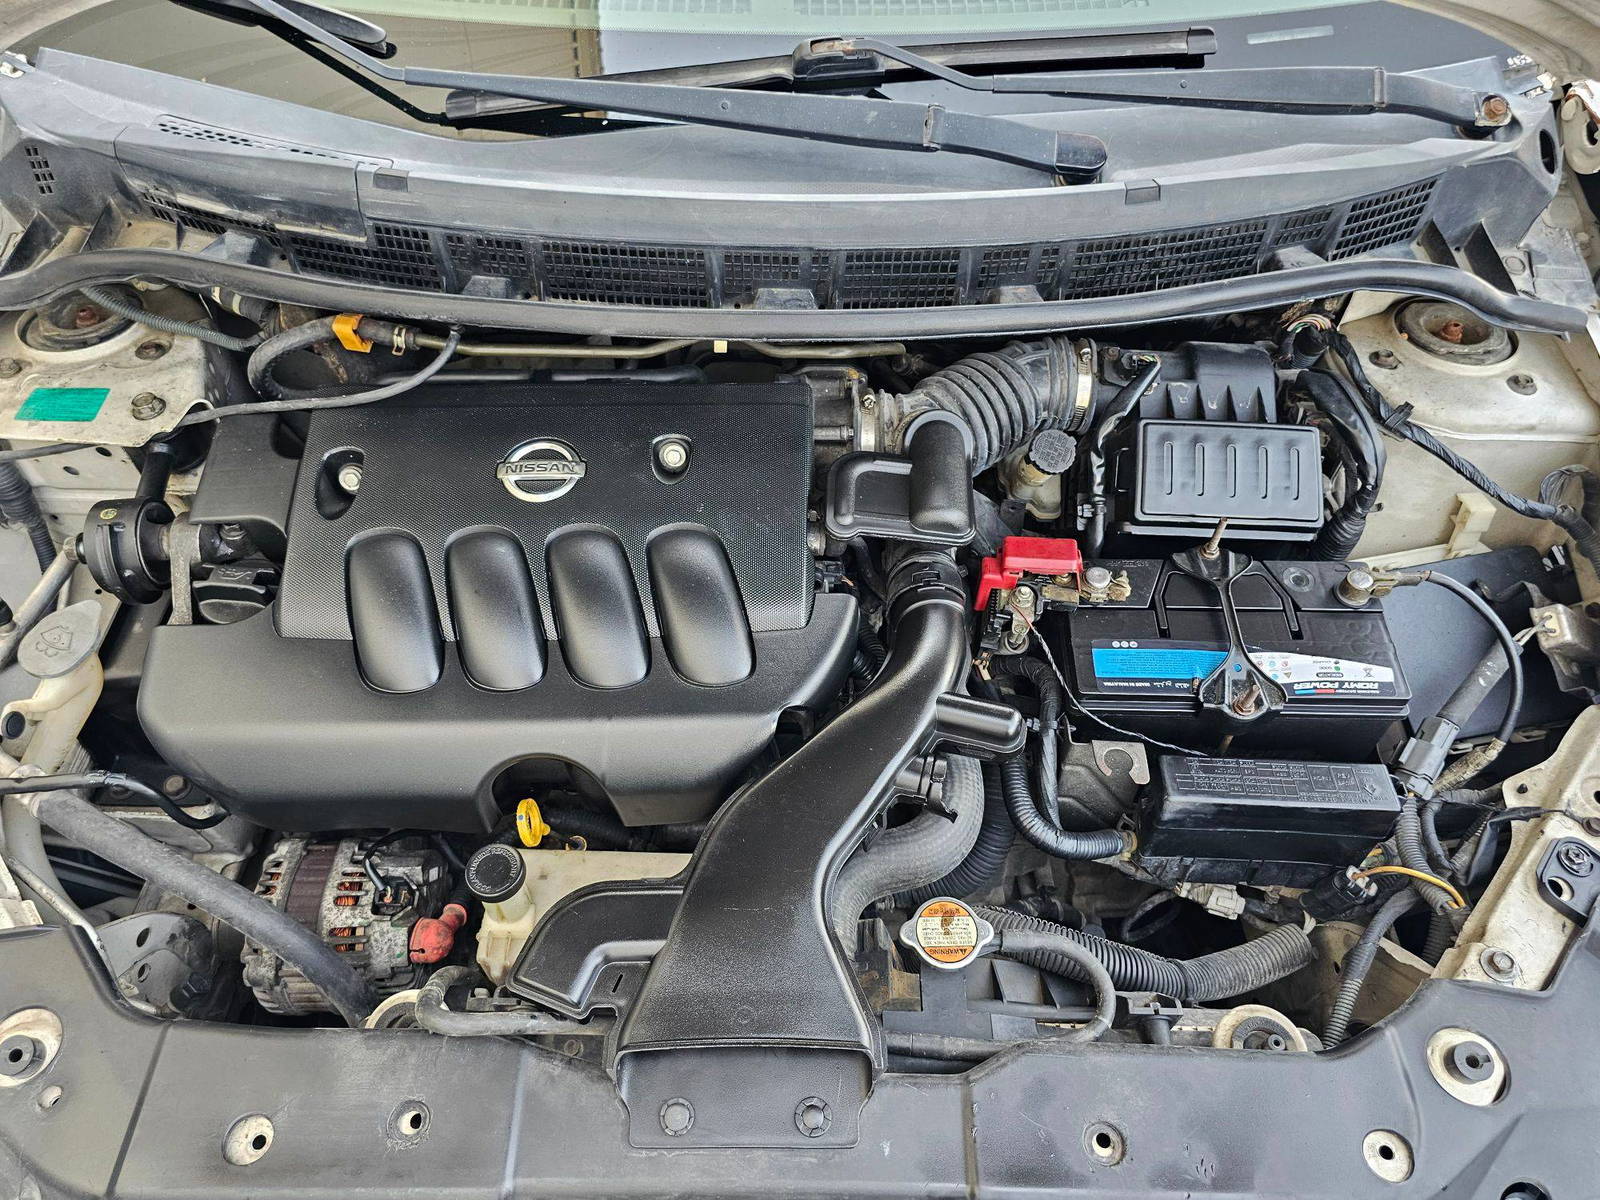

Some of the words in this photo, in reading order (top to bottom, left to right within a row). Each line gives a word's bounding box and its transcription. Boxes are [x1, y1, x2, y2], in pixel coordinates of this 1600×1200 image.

[505, 463, 575, 474] NISSAN
[1293, 681, 1339, 690] POWER
[1343, 682, 1379, 690] ROMY
